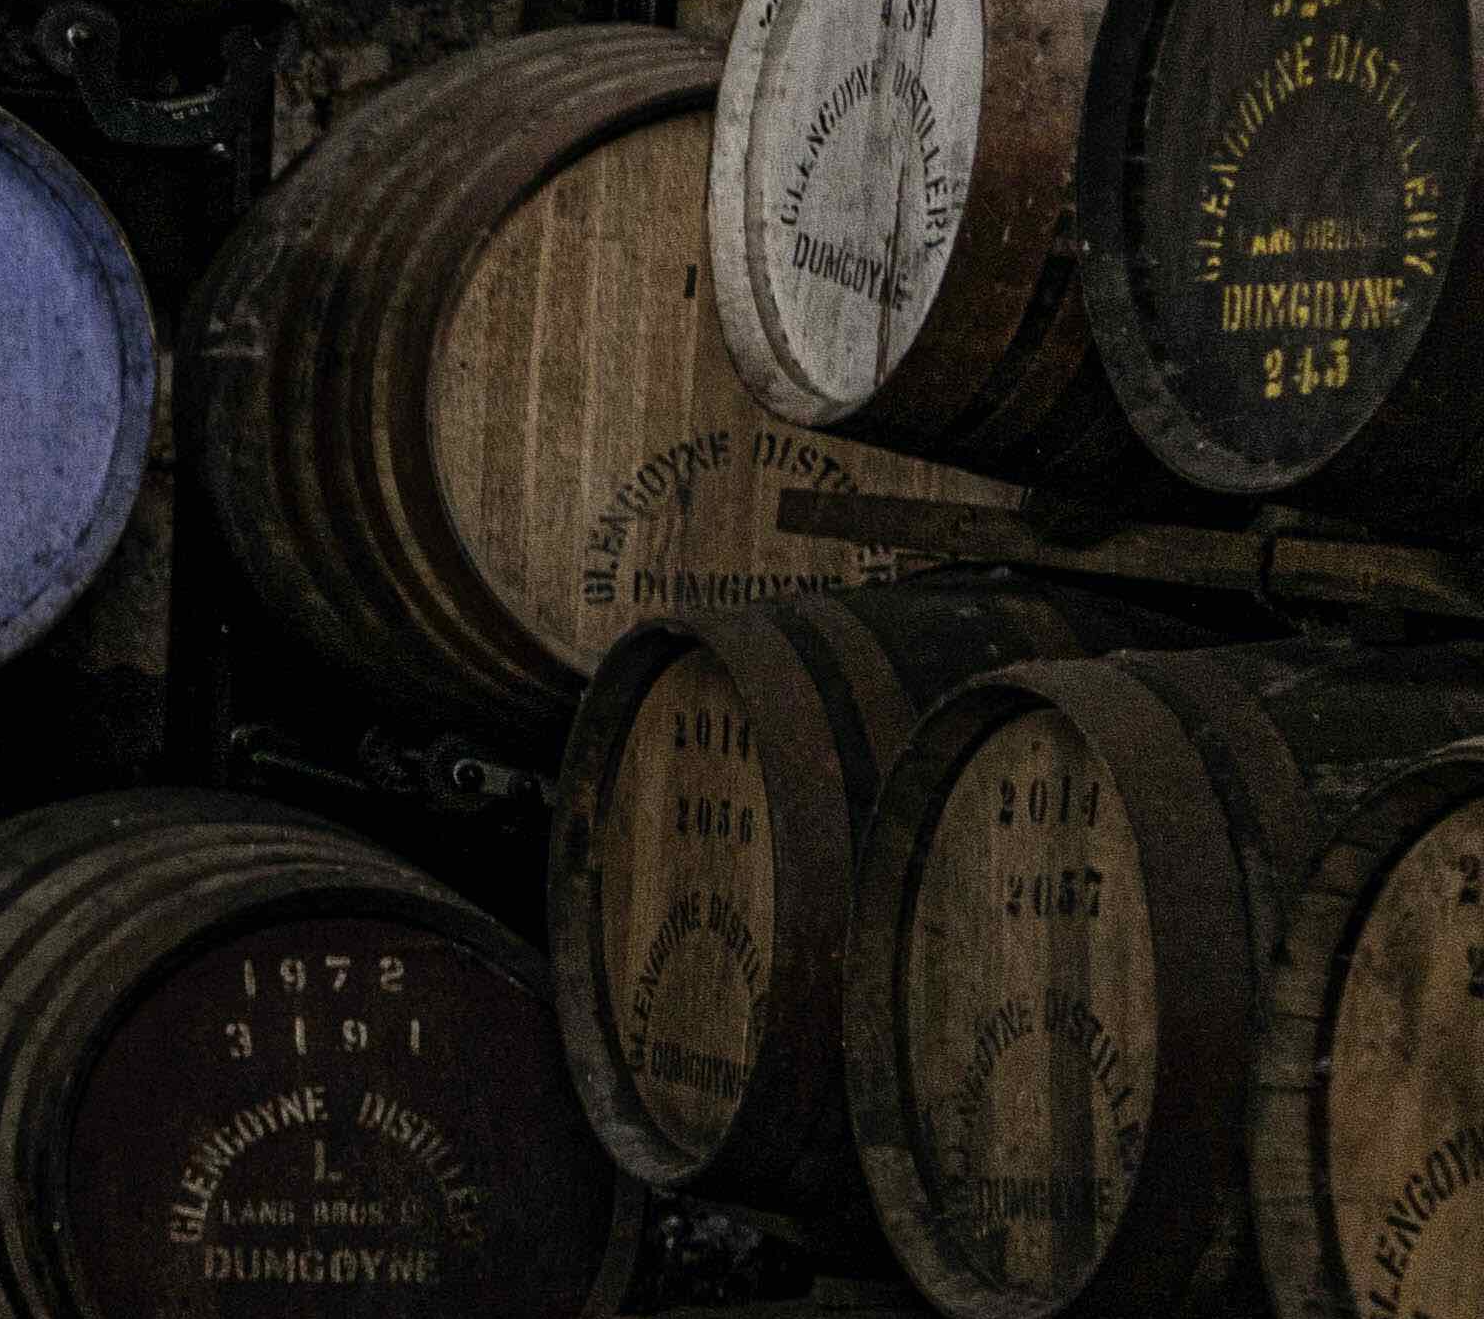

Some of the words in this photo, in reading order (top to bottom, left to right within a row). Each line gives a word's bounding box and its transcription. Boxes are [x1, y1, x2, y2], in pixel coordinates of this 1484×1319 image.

[892, 58, 947, 249] DISTILLERY
[1202, 35, 1314, 280] GLENGOYNE
[1328, 31, 1440, 276] DISTILLERY
[1219, 275, 1406, 332] DUMGOYNE
[998, 776, 1100, 828] 2014
[243, 953, 406, 1002] 1972
[223, 1016, 422, 1060] 3191
[168, 1084, 329, 1243] GLENGOYNE
[219, 1198, 296, 1226] LANG
[312, 1198, 382, 1226] BROS
[201, 1246, 432, 1283] DUMGOYNE
